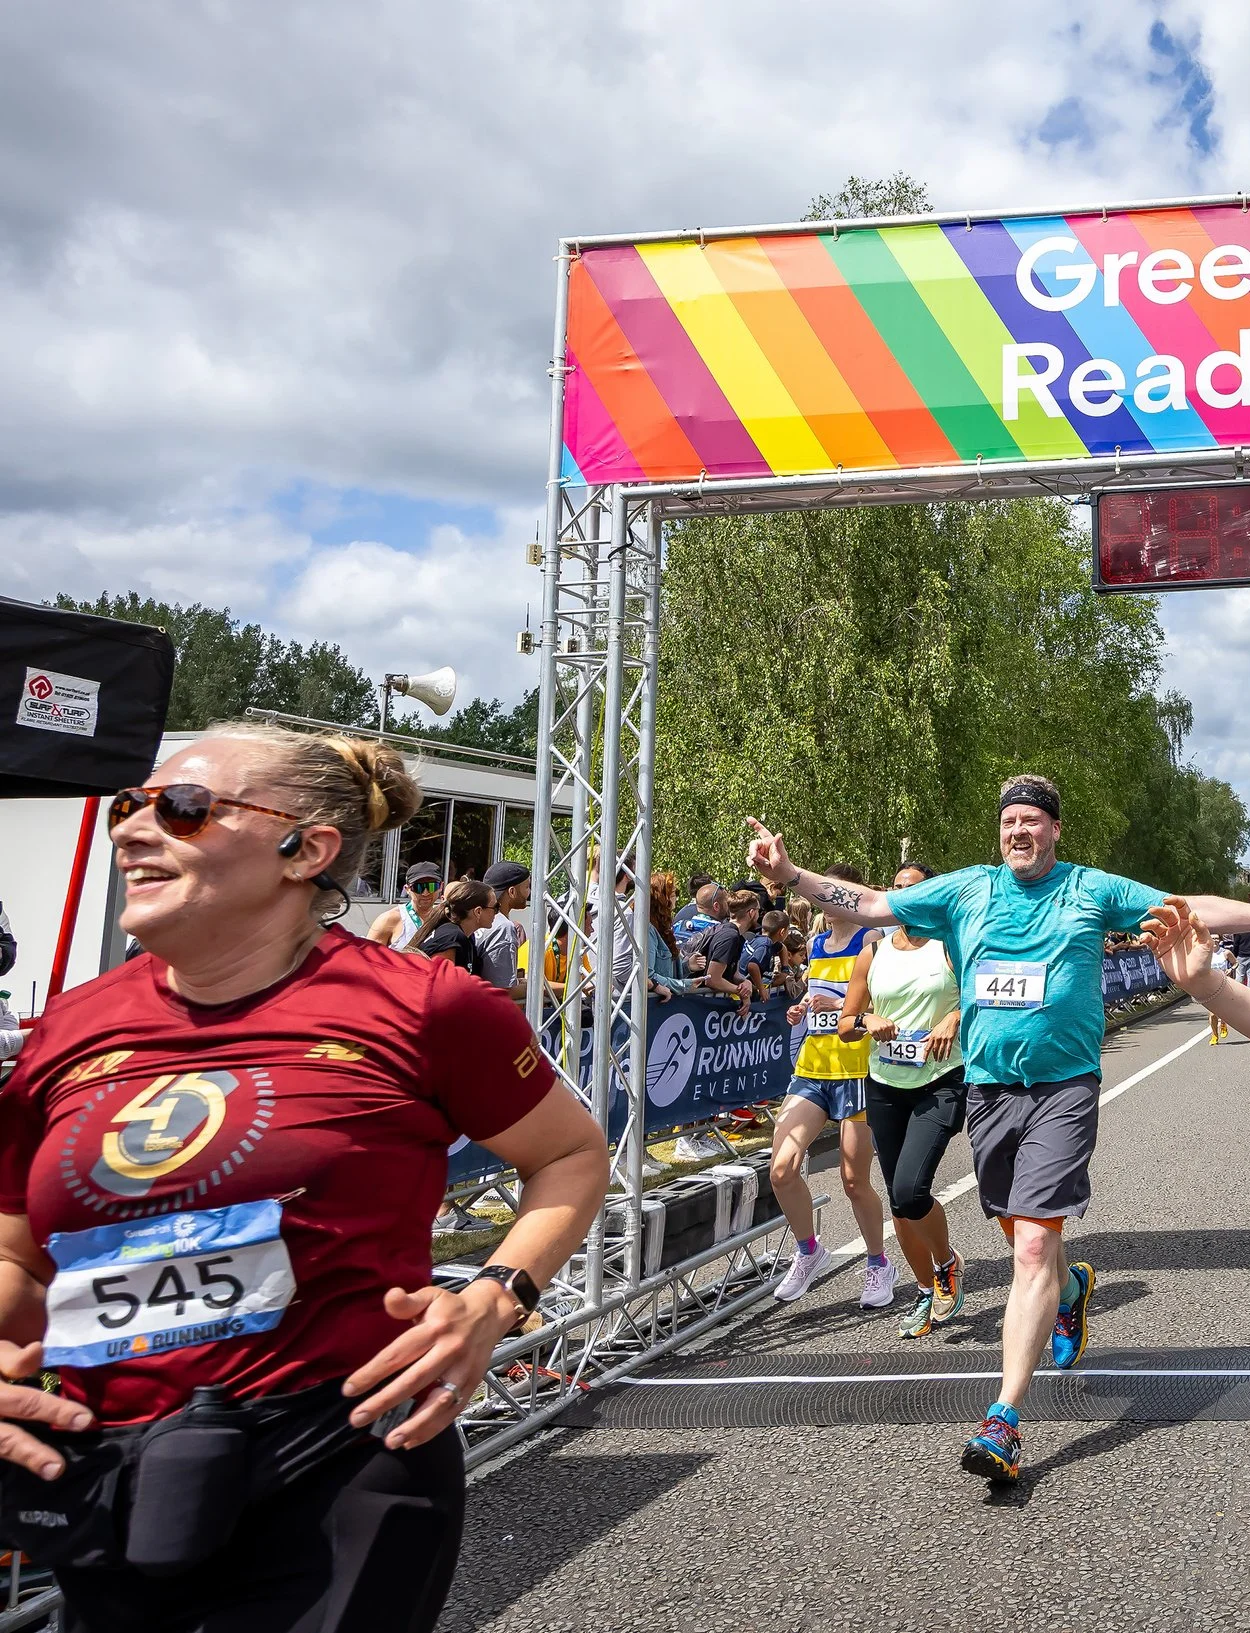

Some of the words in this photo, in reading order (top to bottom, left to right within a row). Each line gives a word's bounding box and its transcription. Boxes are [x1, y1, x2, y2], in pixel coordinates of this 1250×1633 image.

[26, 711, 53, 721] INSTANT
[54, 715, 85, 727] SHELTERS
[29, 701, 53, 711] SURF
[51, 703, 63, 717] &
[63, 707, 86, 717] TURF
[986, 977, 1027, 998] 441
[705, 1010, 767, 1041] GOOD
[811, 1012, 838, 1028] 133
[697, 1034, 783, 1076] RUNNING
[886, 1042, 917, 1060] 149
[693, 1069, 768, 1101] EVENTS
[92, 1256, 245, 1329] 545
[106, 1341, 130, 1358] UP
[152, 1318, 245, 1350] RUNNING
